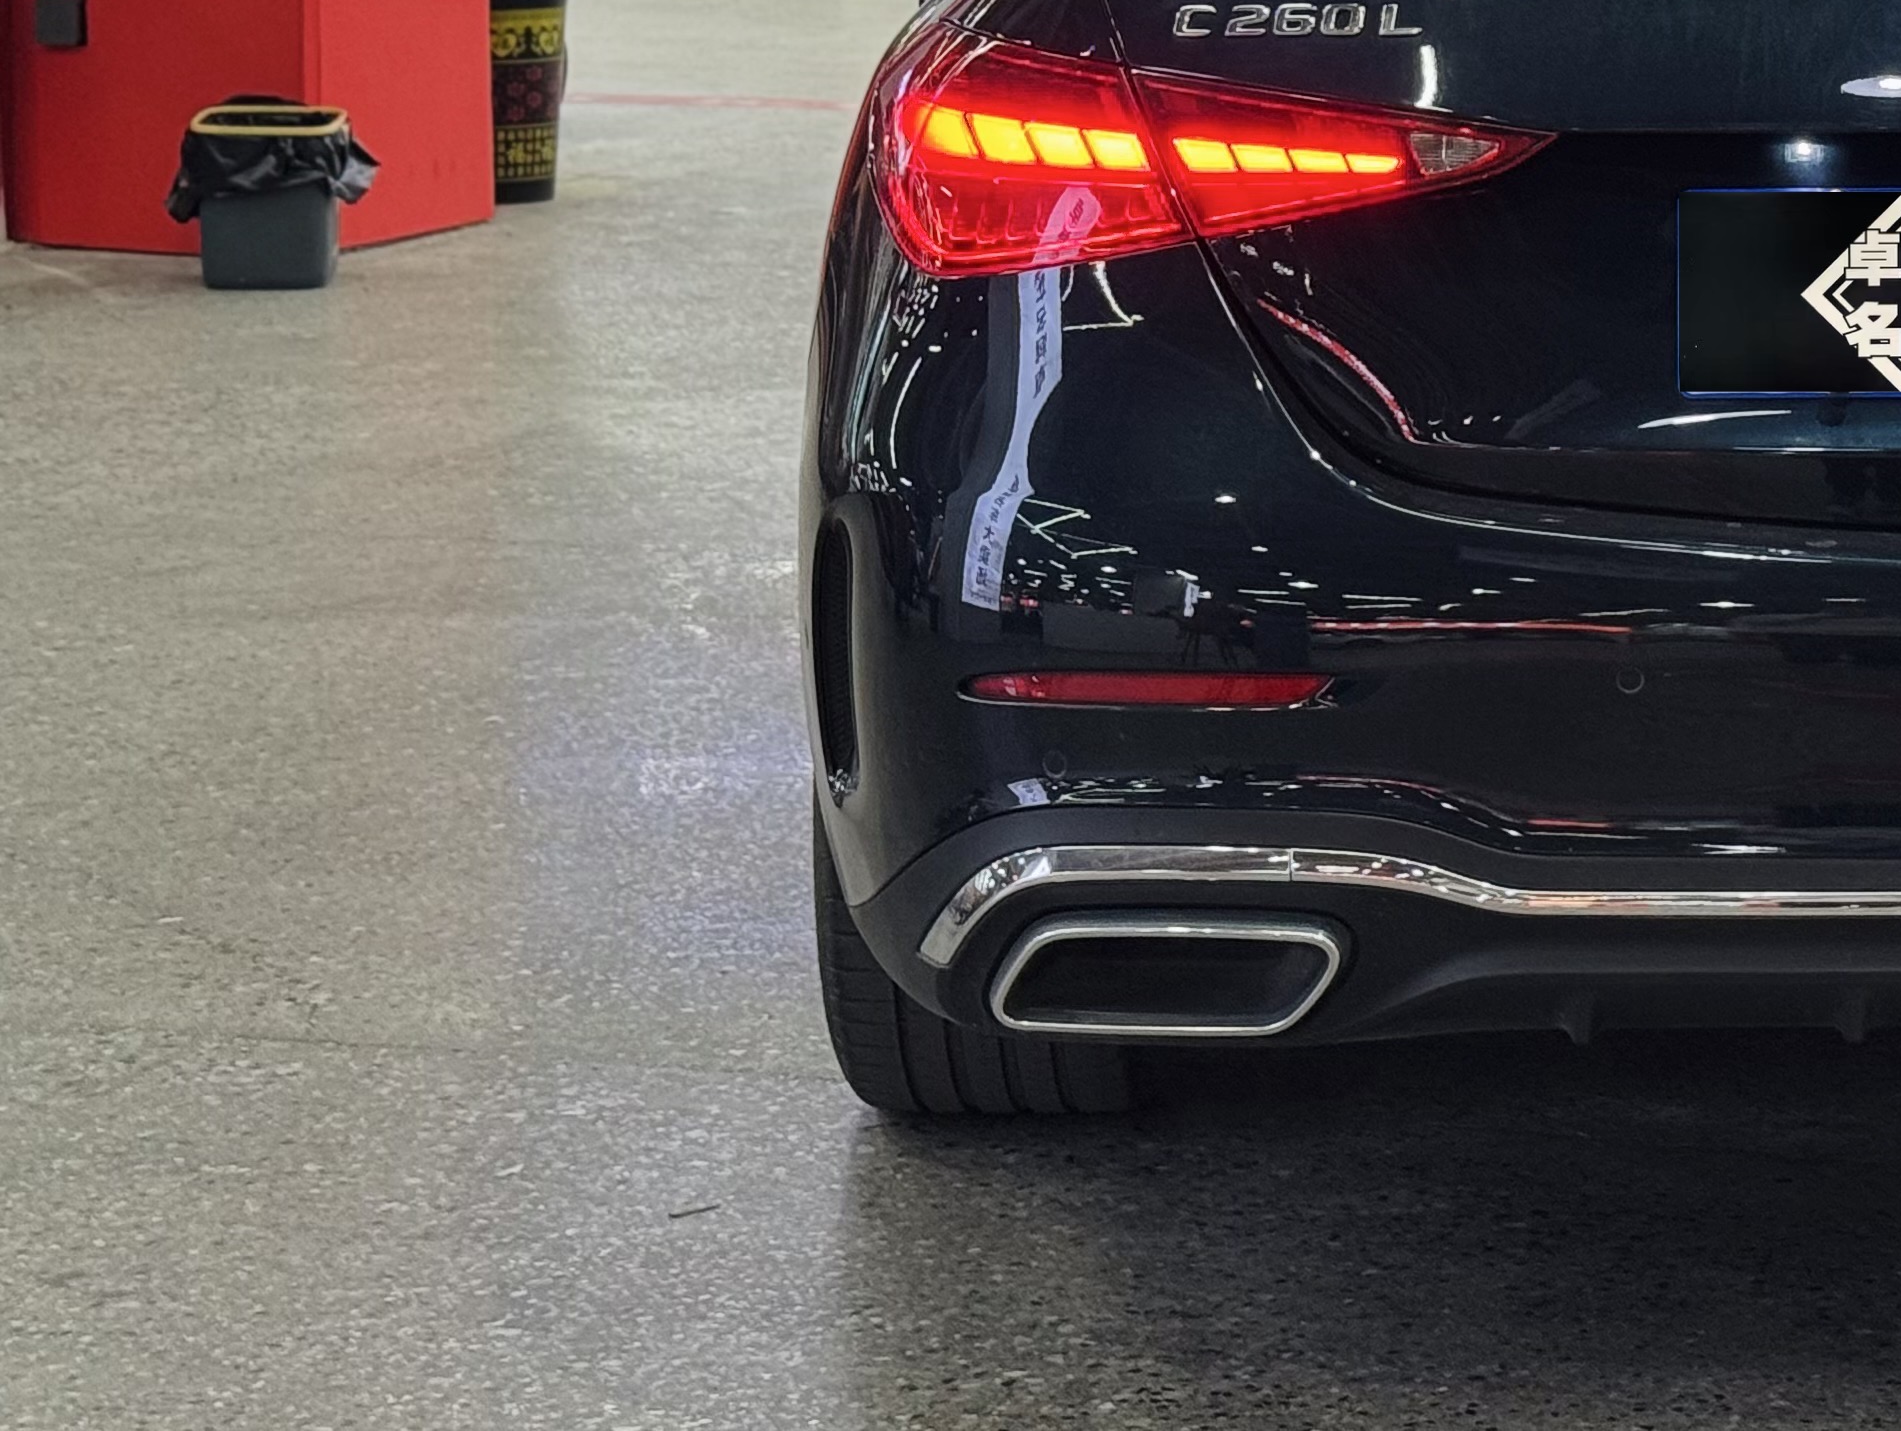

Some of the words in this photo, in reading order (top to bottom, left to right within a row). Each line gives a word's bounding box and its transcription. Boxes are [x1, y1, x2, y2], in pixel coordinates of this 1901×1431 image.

[1173, 4, 1217, 37] C
[1224, 2, 1367, 37] 260
[1378, 3, 1423, 37] L
